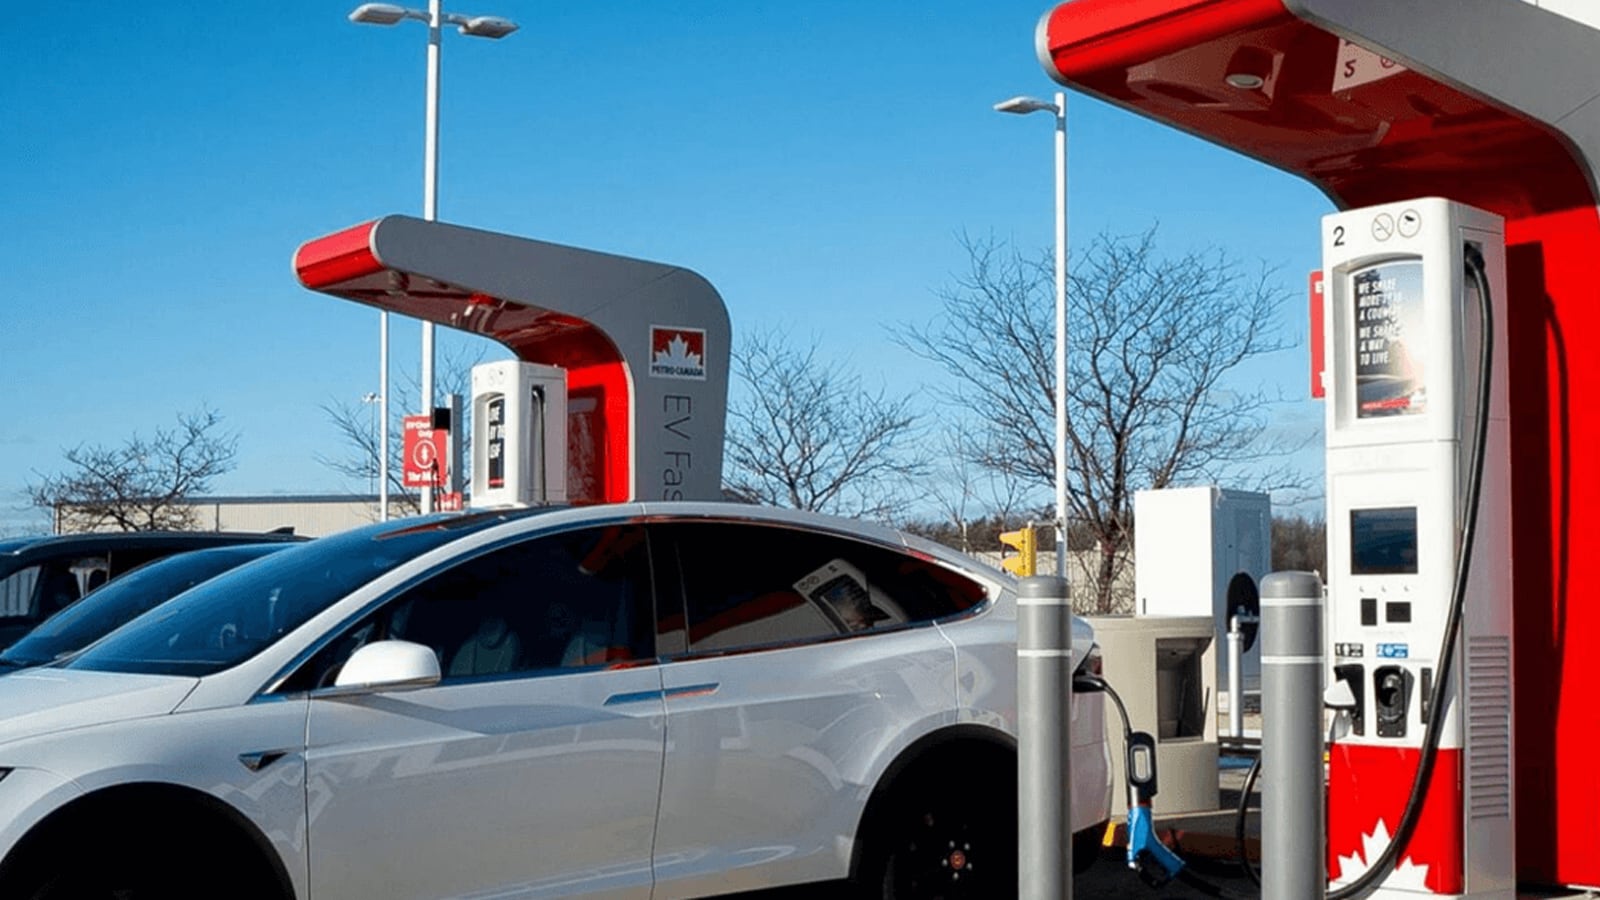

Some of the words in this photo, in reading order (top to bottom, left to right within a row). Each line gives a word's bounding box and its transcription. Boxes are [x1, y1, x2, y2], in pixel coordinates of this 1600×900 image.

[1333, 226, 1345, 247] 2
[1358, 282, 1370, 294] WE
[1360, 309, 1366, 320] A
[1359, 326, 1370, 339] WE
[1360, 340, 1366, 352] A
[1368, 338, 1384, 352] WAY
[1360, 352, 1370, 366] TO
[663, 394, 691, 440] EV
[663, 451, 691, 502] Fas
